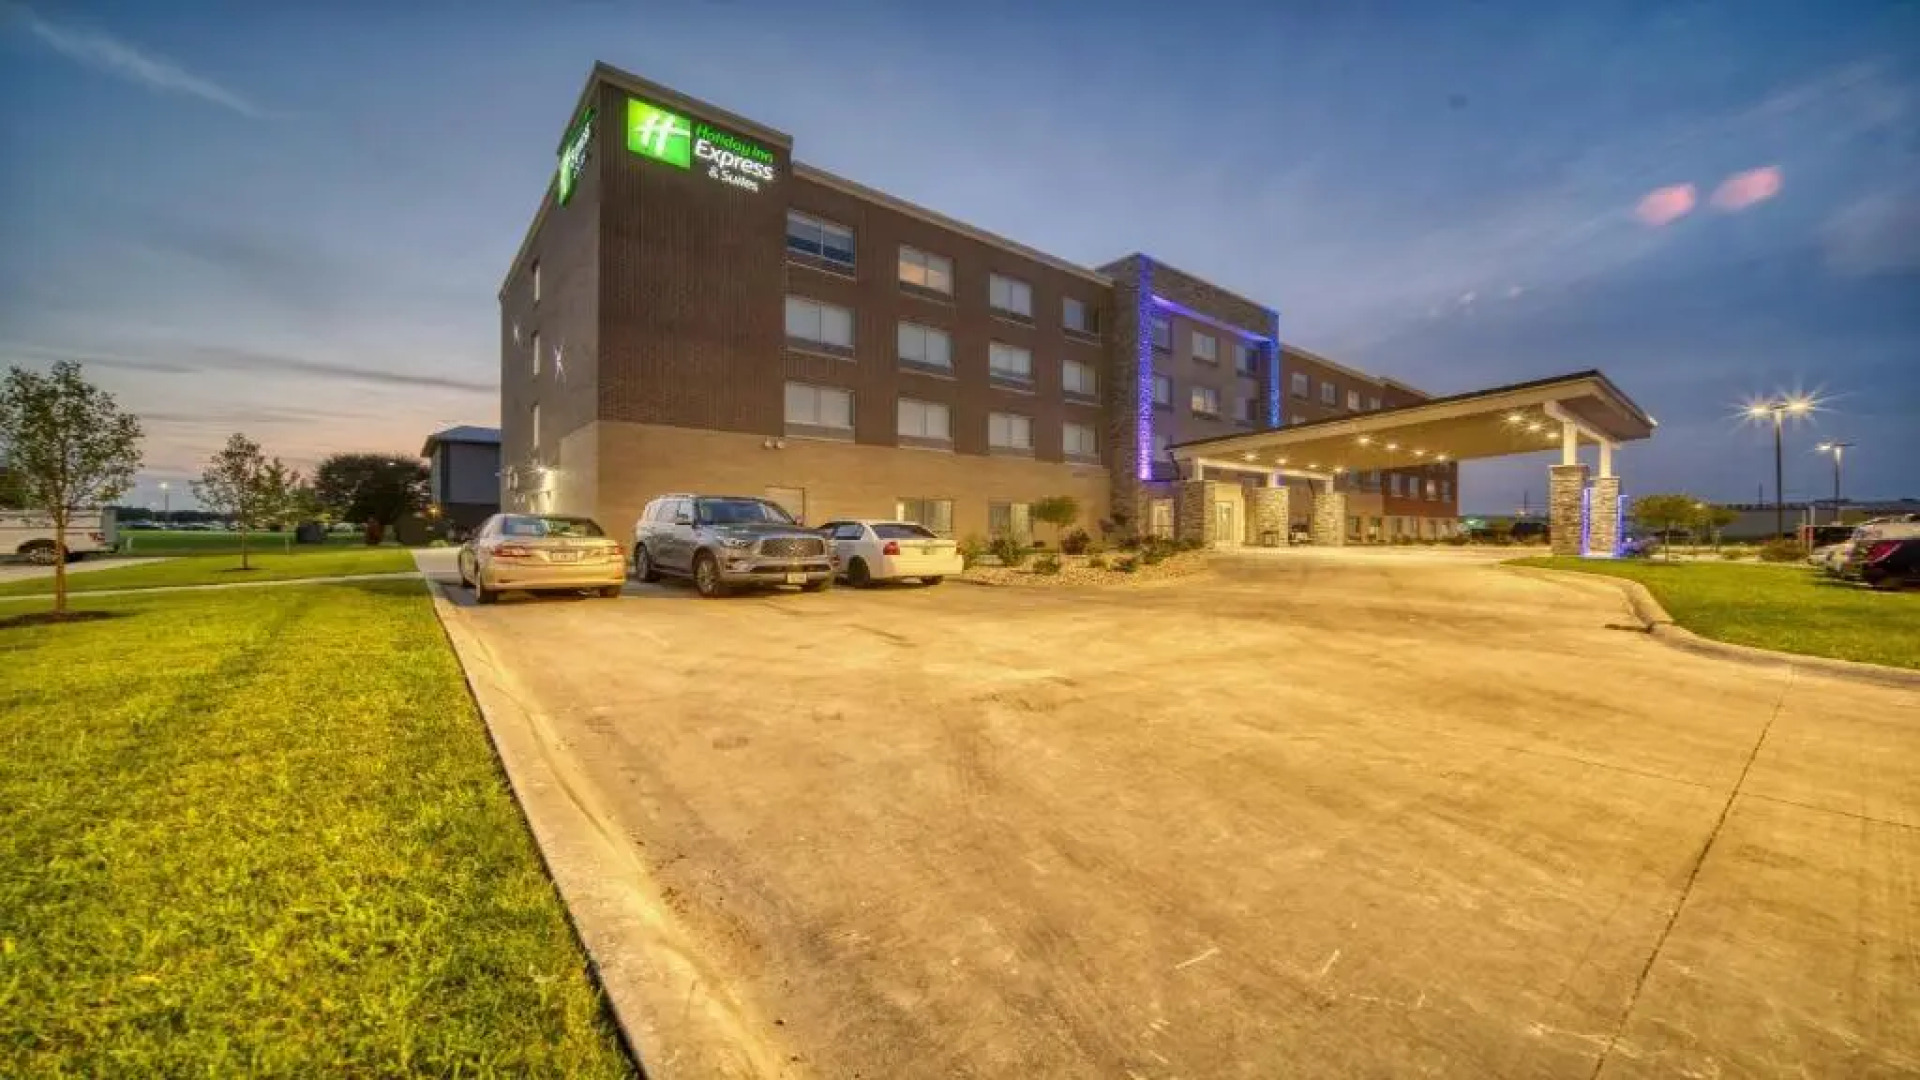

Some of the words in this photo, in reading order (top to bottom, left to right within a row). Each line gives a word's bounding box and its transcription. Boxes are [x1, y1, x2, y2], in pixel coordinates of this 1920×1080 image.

[695, 139, 774, 181] Express
[696, 124, 751, 157] Holiday
[752, 144, 773, 163] Inn
[708, 165, 719, 179] &
[721, 170, 759, 193] Suites
